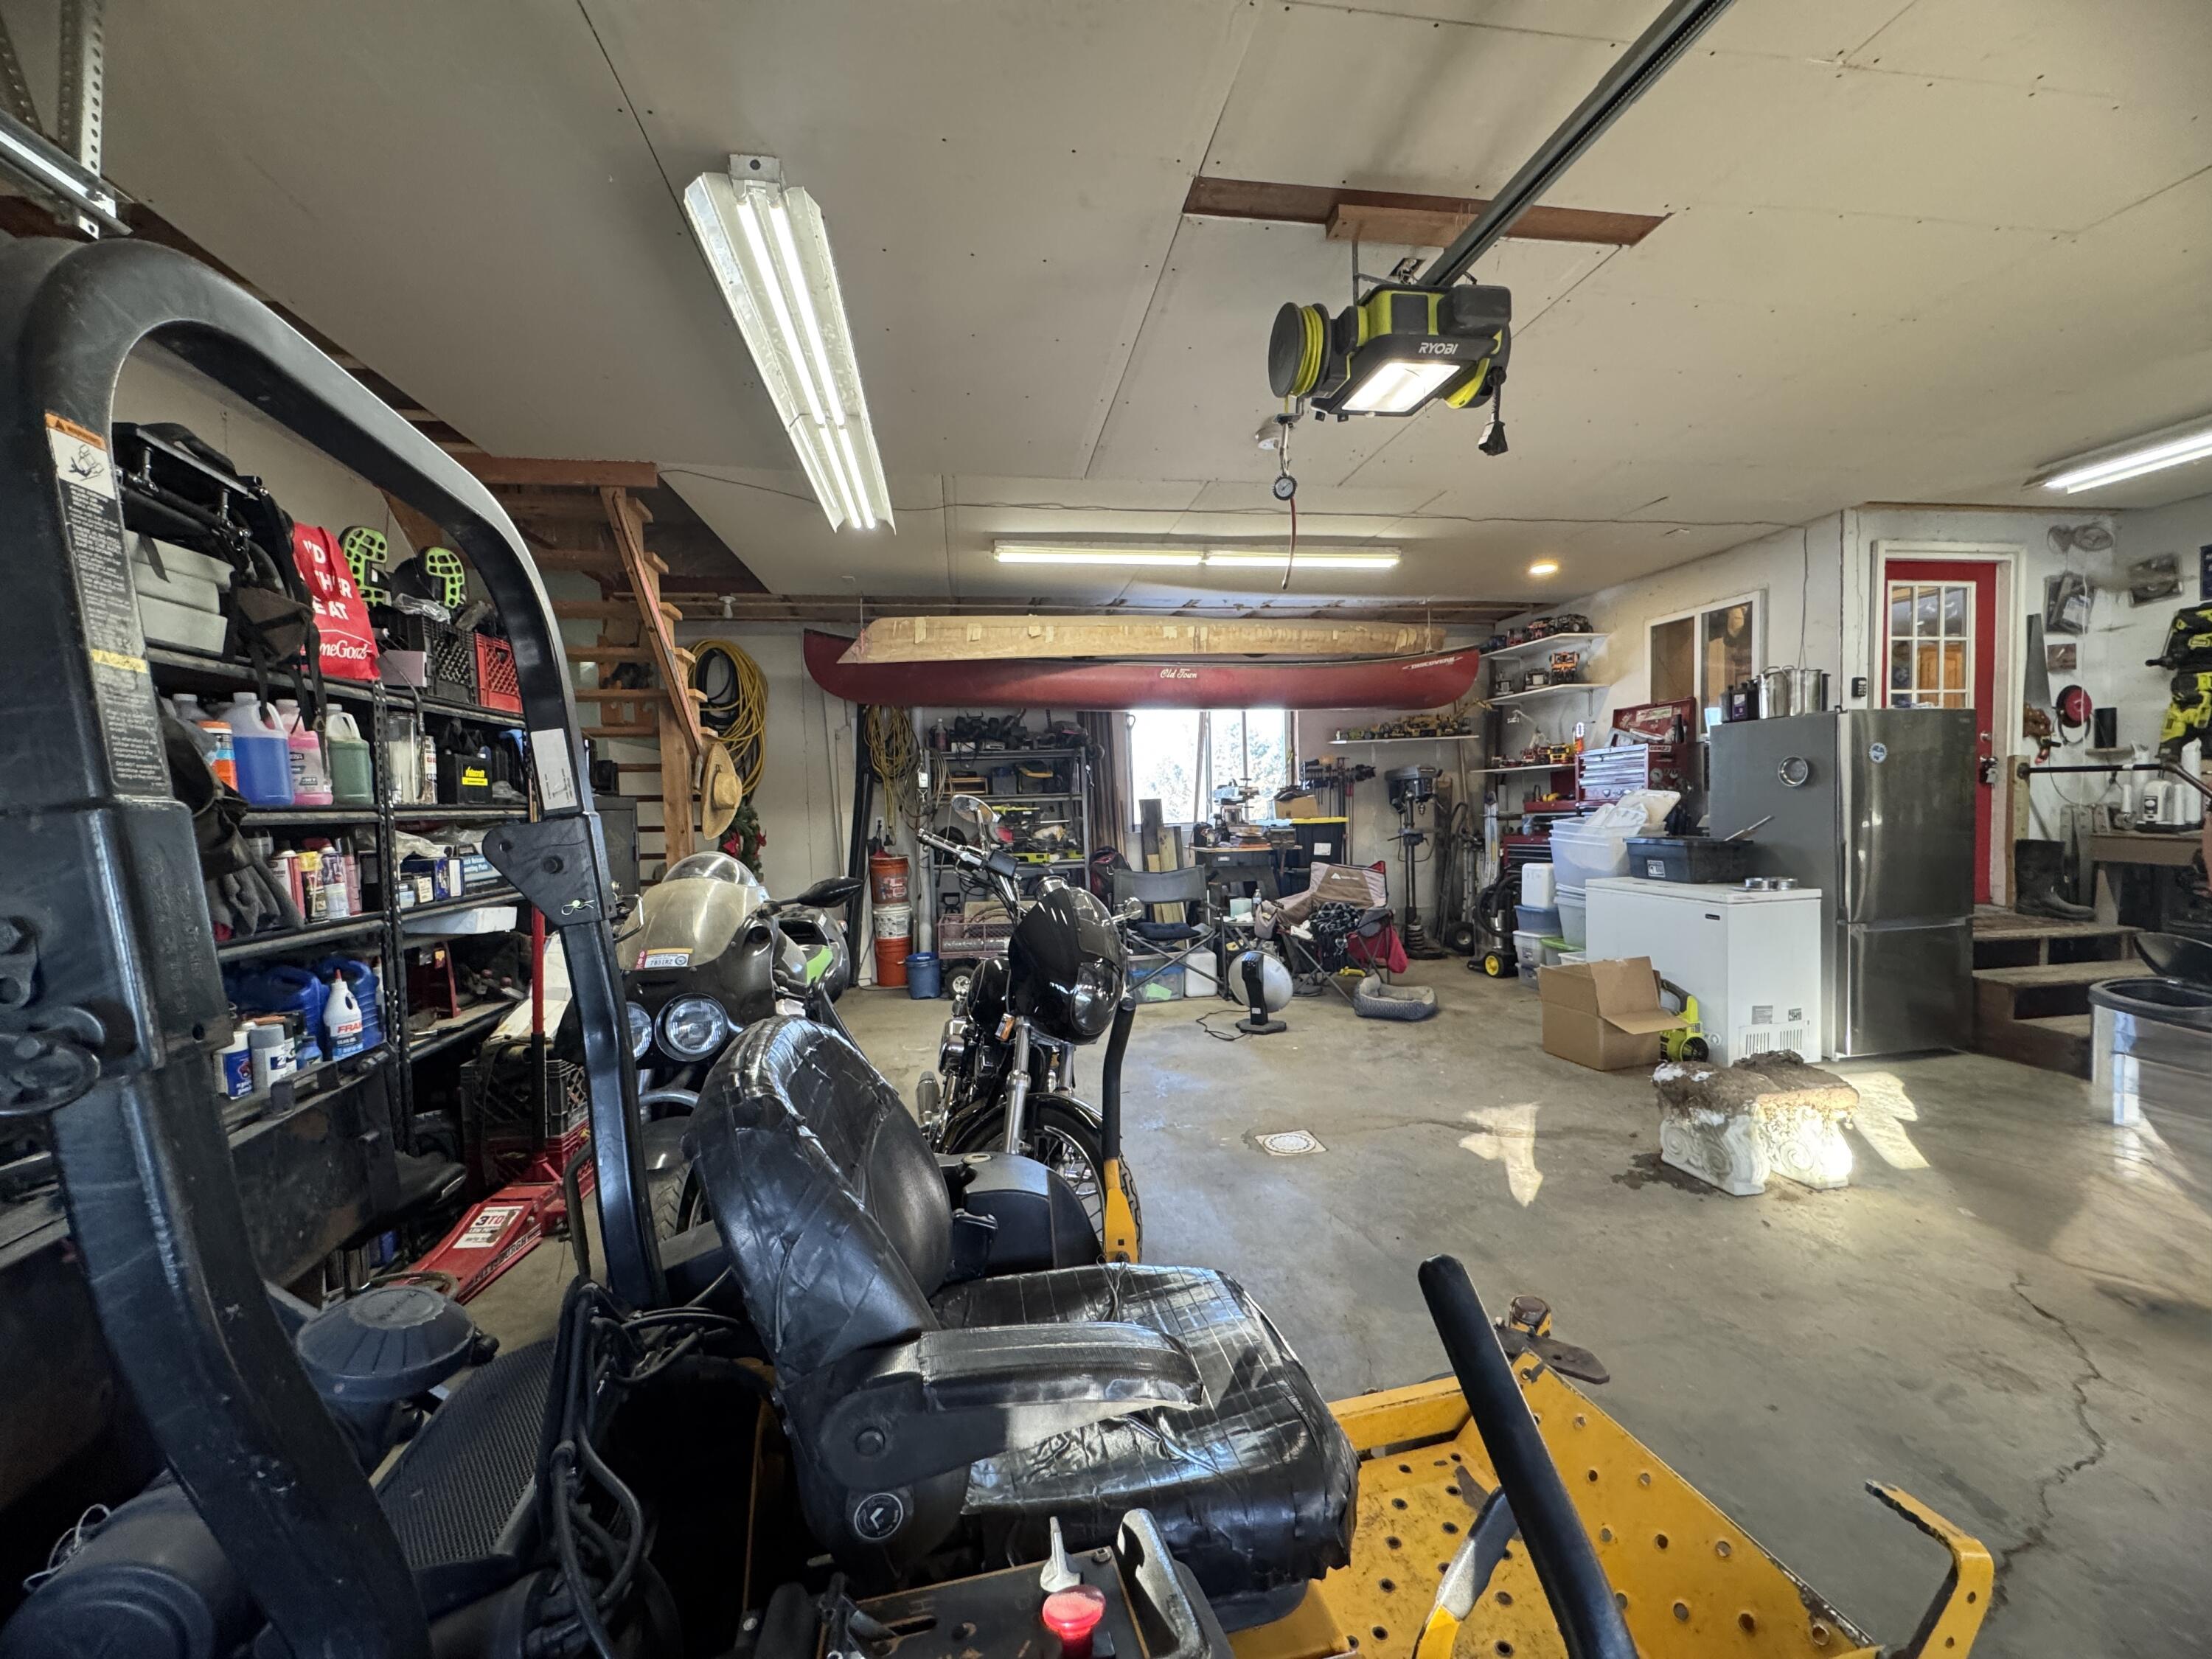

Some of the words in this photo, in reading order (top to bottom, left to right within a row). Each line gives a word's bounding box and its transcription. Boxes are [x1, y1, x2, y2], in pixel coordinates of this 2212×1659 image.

[1418, 342, 1458, 355] RYOBI
[328, 601, 349, 620] AT
[1160, 668, 1178, 678] Old
[1177, 668, 1197, 678] Town
